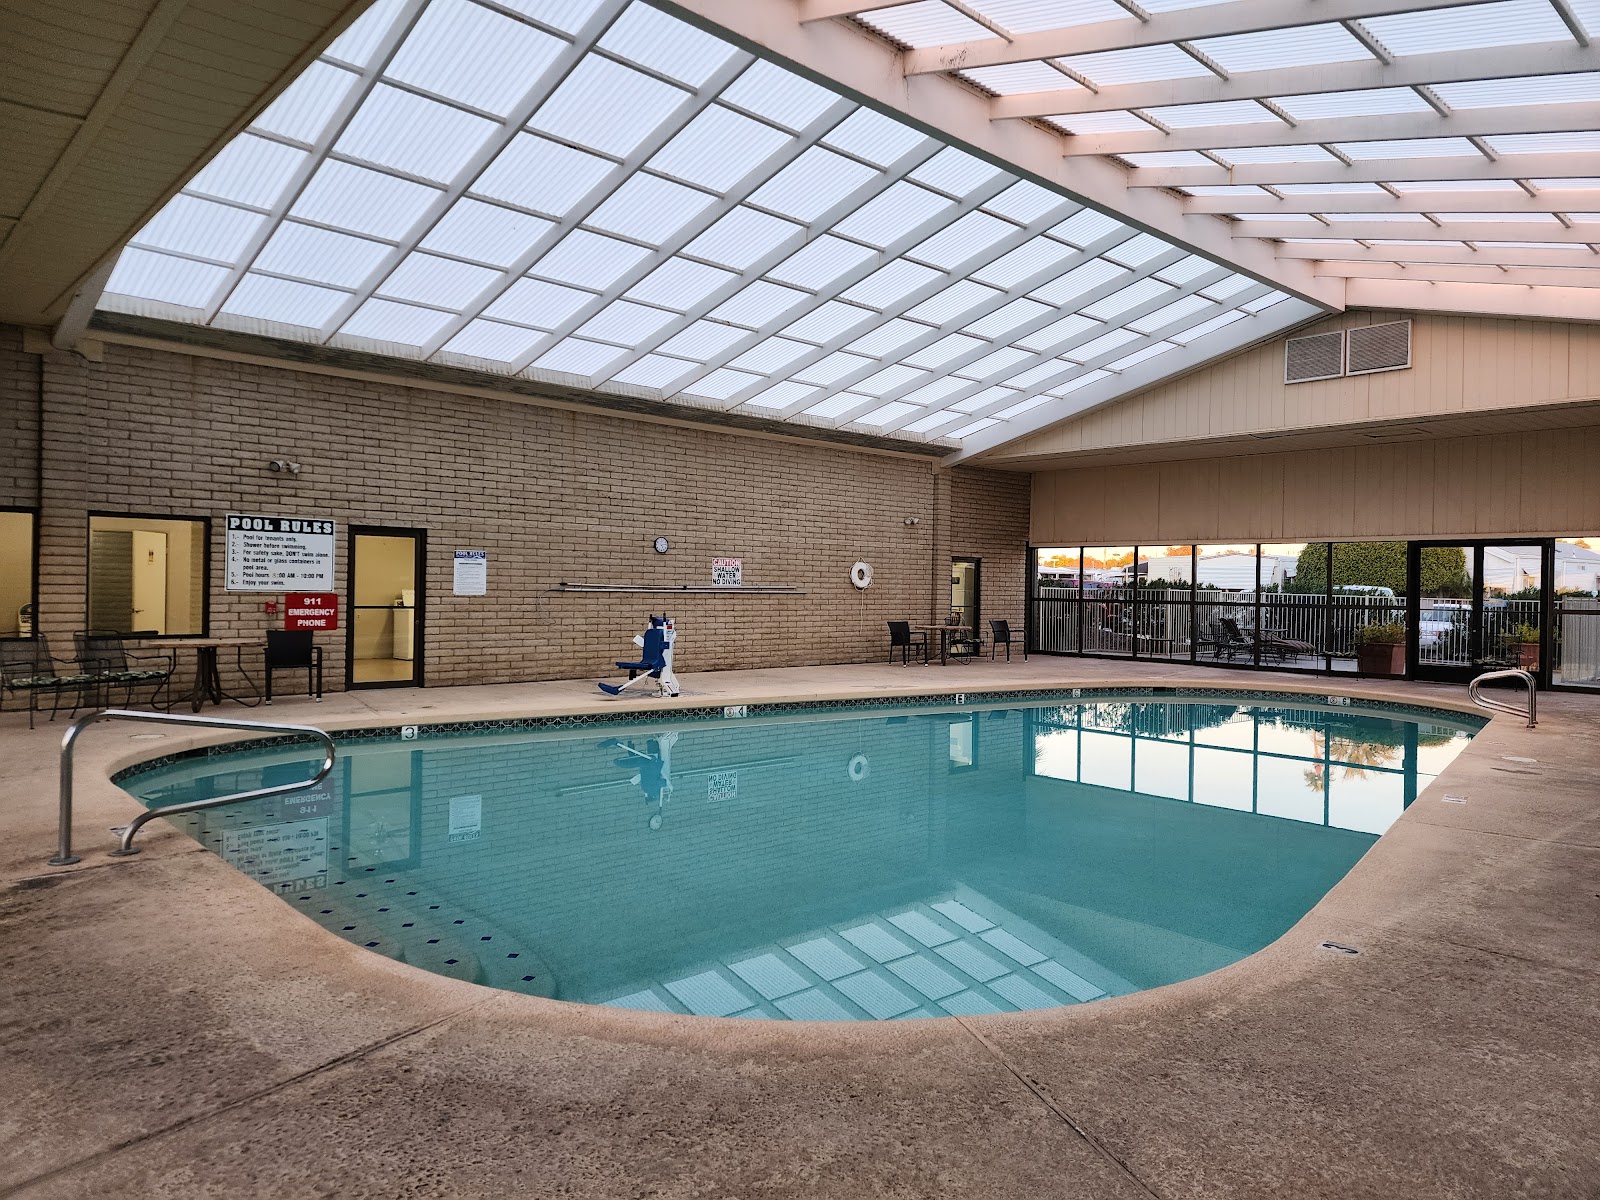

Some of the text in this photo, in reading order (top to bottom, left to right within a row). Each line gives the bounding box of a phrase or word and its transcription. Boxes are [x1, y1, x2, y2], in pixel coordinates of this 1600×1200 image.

[230, 518, 332, 534] POOL RULES
[405, 727, 414, 739] 3
